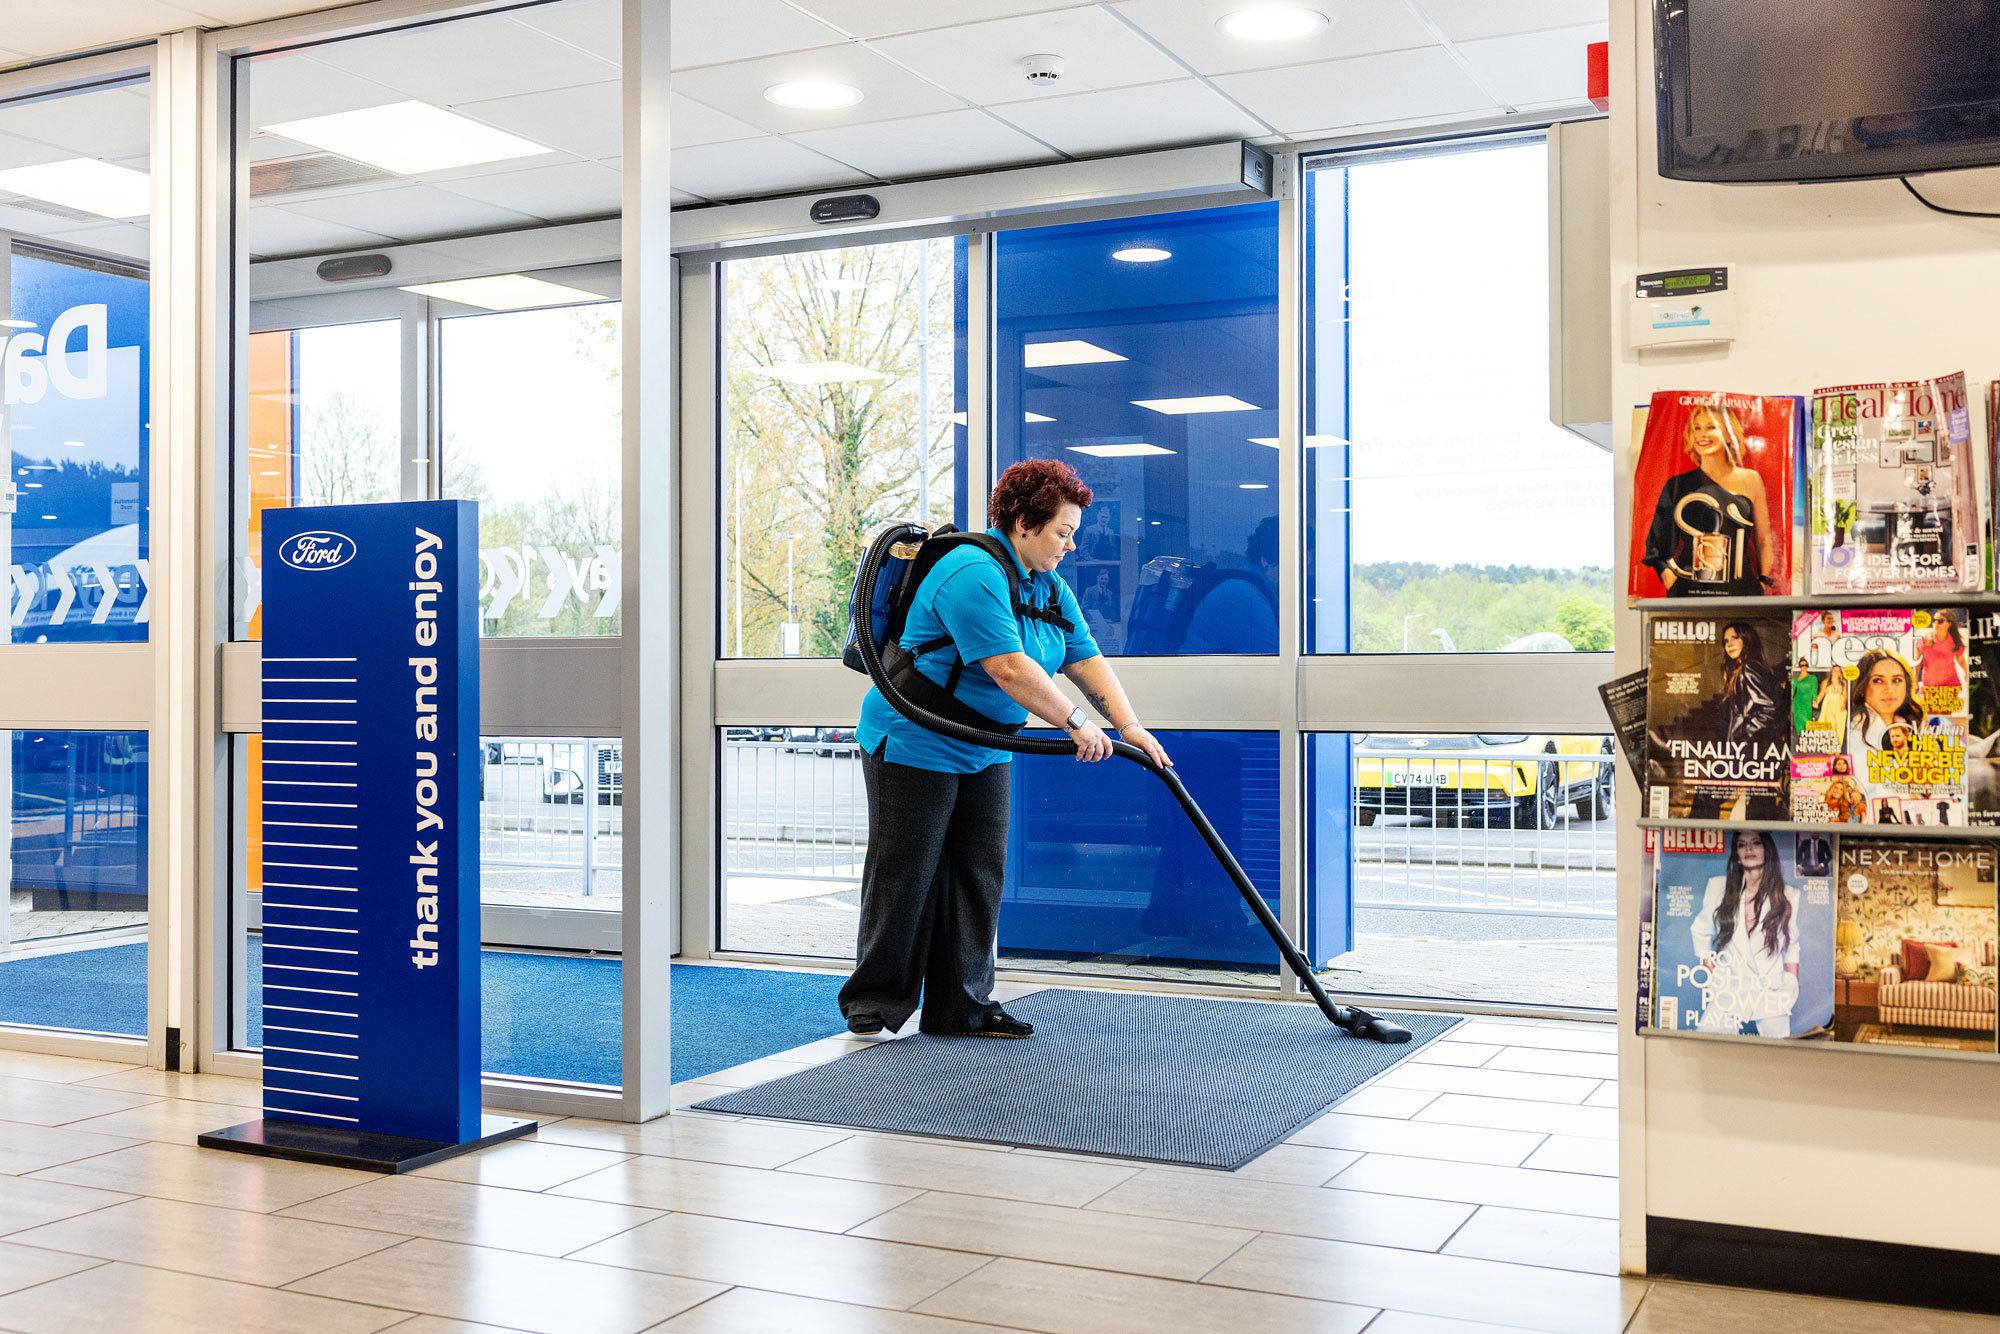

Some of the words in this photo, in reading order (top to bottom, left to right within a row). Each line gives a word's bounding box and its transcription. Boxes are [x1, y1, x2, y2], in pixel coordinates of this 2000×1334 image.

[1721, 398, 1755, 410] ARMANI
[1820, 391, 1884, 423] Ideal
[1890, 386, 1966, 418] Home
[1851, 448, 1880, 464] less
[292, 535, 342, 566] Ford
[1868, 555, 1908, 567] IDEAS
[1914, 554, 1942, 566] FOR
[1835, 568, 1900, 579] FOEVER
[1904, 566, 1956, 578] HOMES
[408, 527, 443, 647] enjoy
[1655, 621, 1716, 640] HELLO!
[1842, 617, 1880, 625] WEDDING
[1881, 617, 1910, 625] DREAM
[1847, 624, 1869, 632] ENDS
[1878, 624, 1905, 632] TEARS
[1797, 622, 1924, 668] heat
[408, 658, 439, 742] and
[1801, 730, 1837, 738] HARPER
[1908, 734, 1966, 752] 'HE'LL
[1666, 740, 1748, 760] 'FINALLY,
[1753, 742, 1759, 760] I
[1796, 744, 1817, 752] NEW
[1867, 750, 1936, 768] NEVER
[1938, 751, 1966, 769] BE
[1394, 773, 1422, 785] CV74
[1684, 760, 1780, 780] ENOUGH'
[1869, 766, 1966, 785] ENOUGH'
[415, 752, 444, 830] you
[1664, 829, 1723, 849] HELLO!
[1841, 850, 1908, 866] NEXT
[1918, 851, 1991, 869] HOME
[409, 840, 439, 969] thank
[1700, 951, 1748, 967] FROM
[1677, 965, 1743, 988] POSH
[1750, 975, 1771, 989] TO
[1702, 989, 1792, 1015] POWER
[1686, 1010, 1744, 1029] PLAYER
